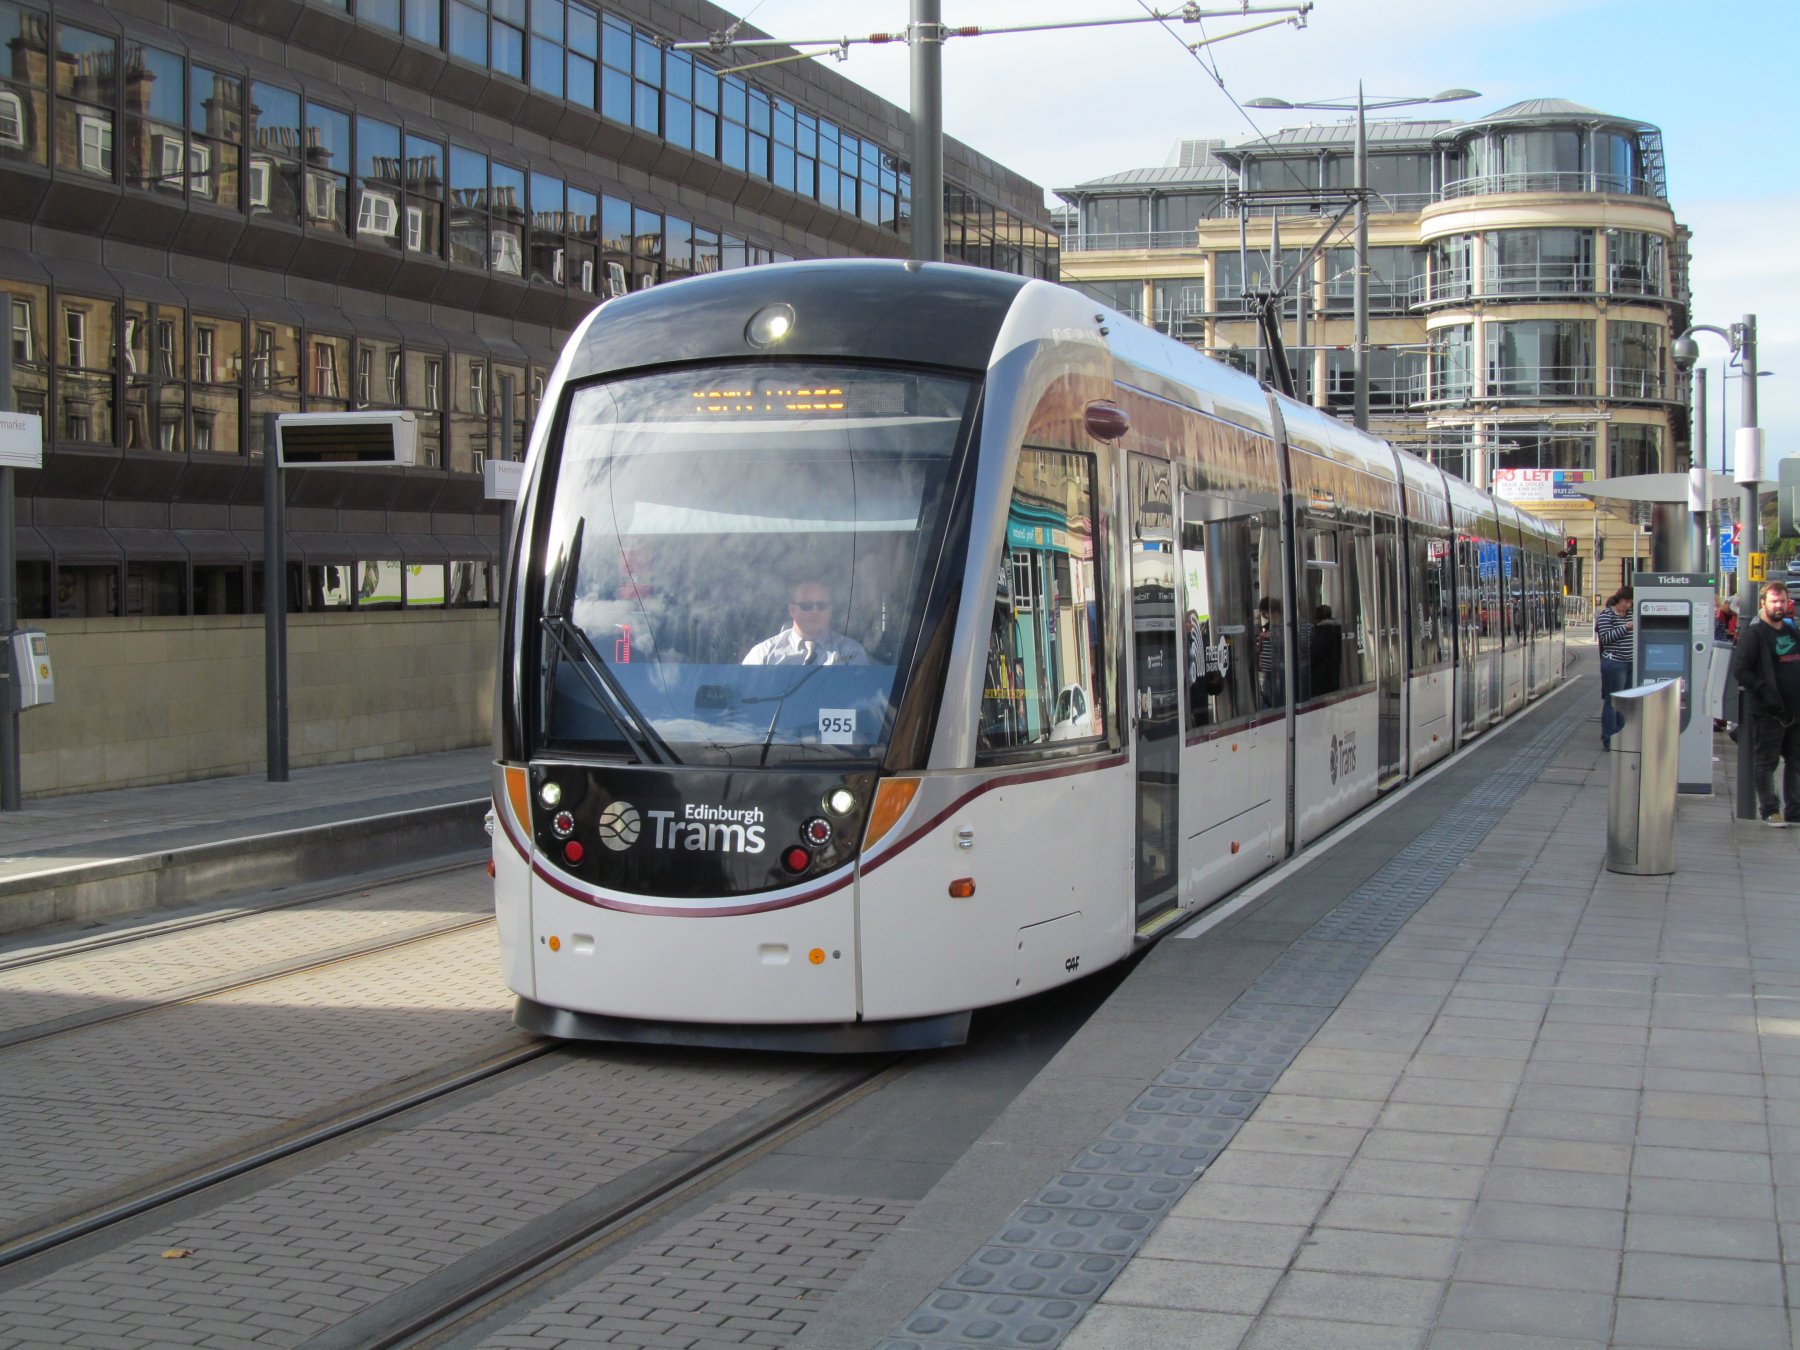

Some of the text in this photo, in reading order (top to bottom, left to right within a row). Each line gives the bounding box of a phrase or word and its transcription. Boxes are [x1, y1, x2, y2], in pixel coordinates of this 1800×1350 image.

[0, 419, 26, 431] market
[1523, 470, 1551, 481] LET
[1658, 576, 1690, 584] Tickets
[821, 717, 853, 733] 955
[684, 803, 764, 825] Edinburgh
[647, 810, 766, 854] Trams
